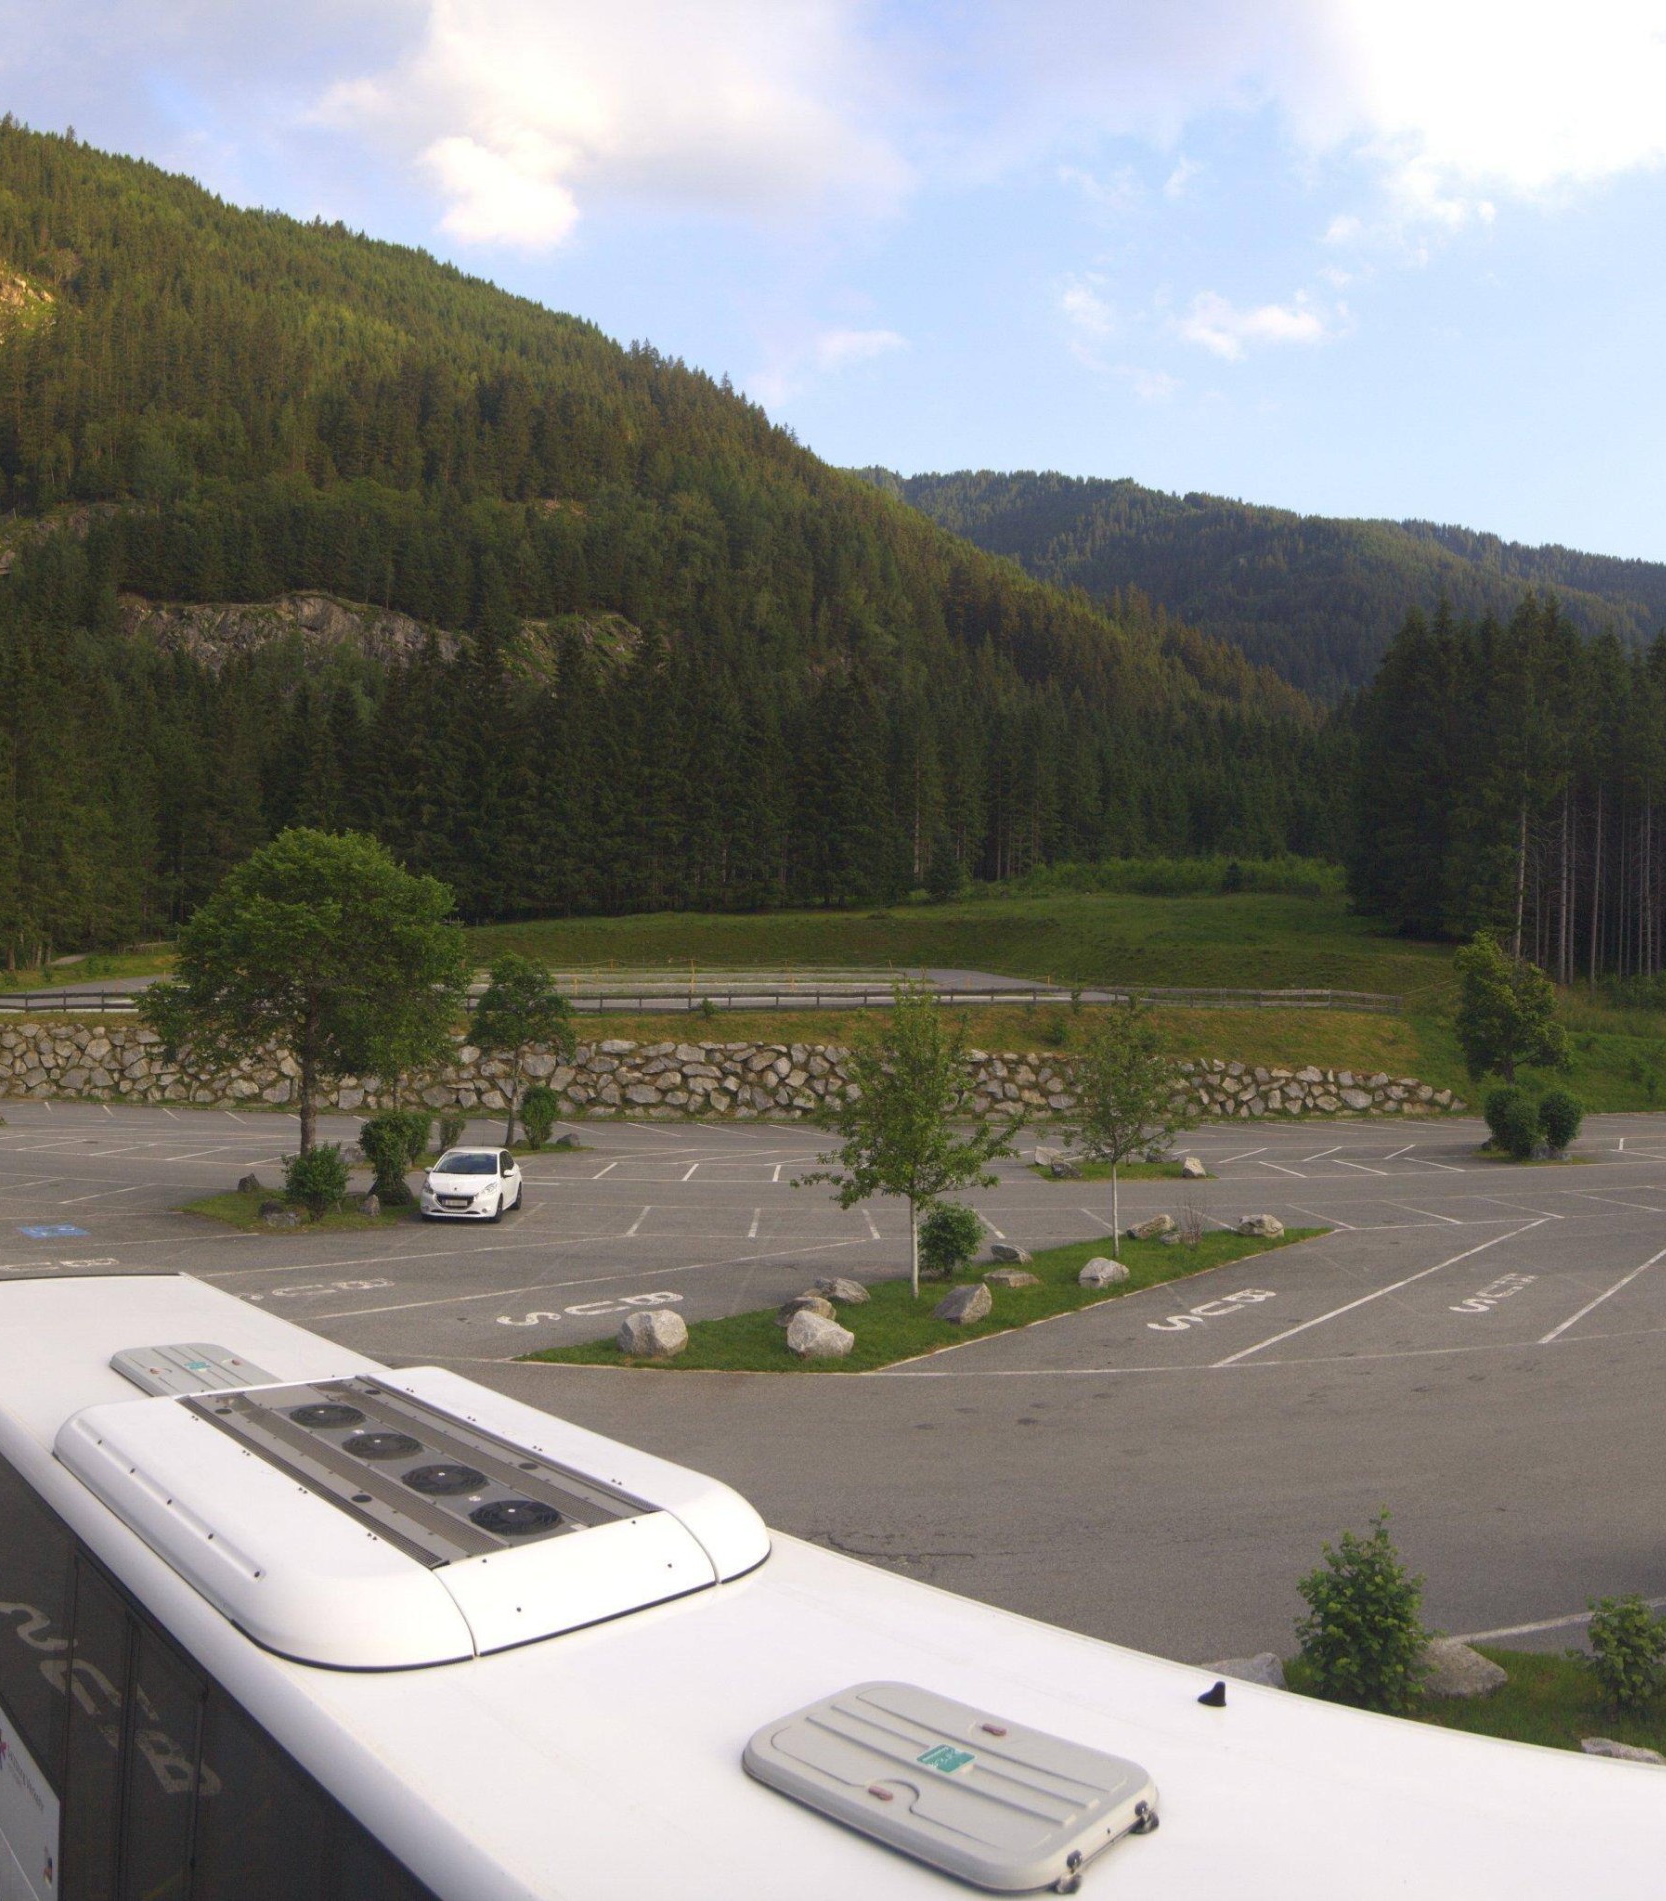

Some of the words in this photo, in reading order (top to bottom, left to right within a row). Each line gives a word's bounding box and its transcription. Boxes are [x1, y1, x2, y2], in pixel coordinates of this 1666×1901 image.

[496, 1292, 684, 1326] BUS
[1147, 1288, 1277, 1331] BUS
[1449, 1273, 1538, 1313] BUS
